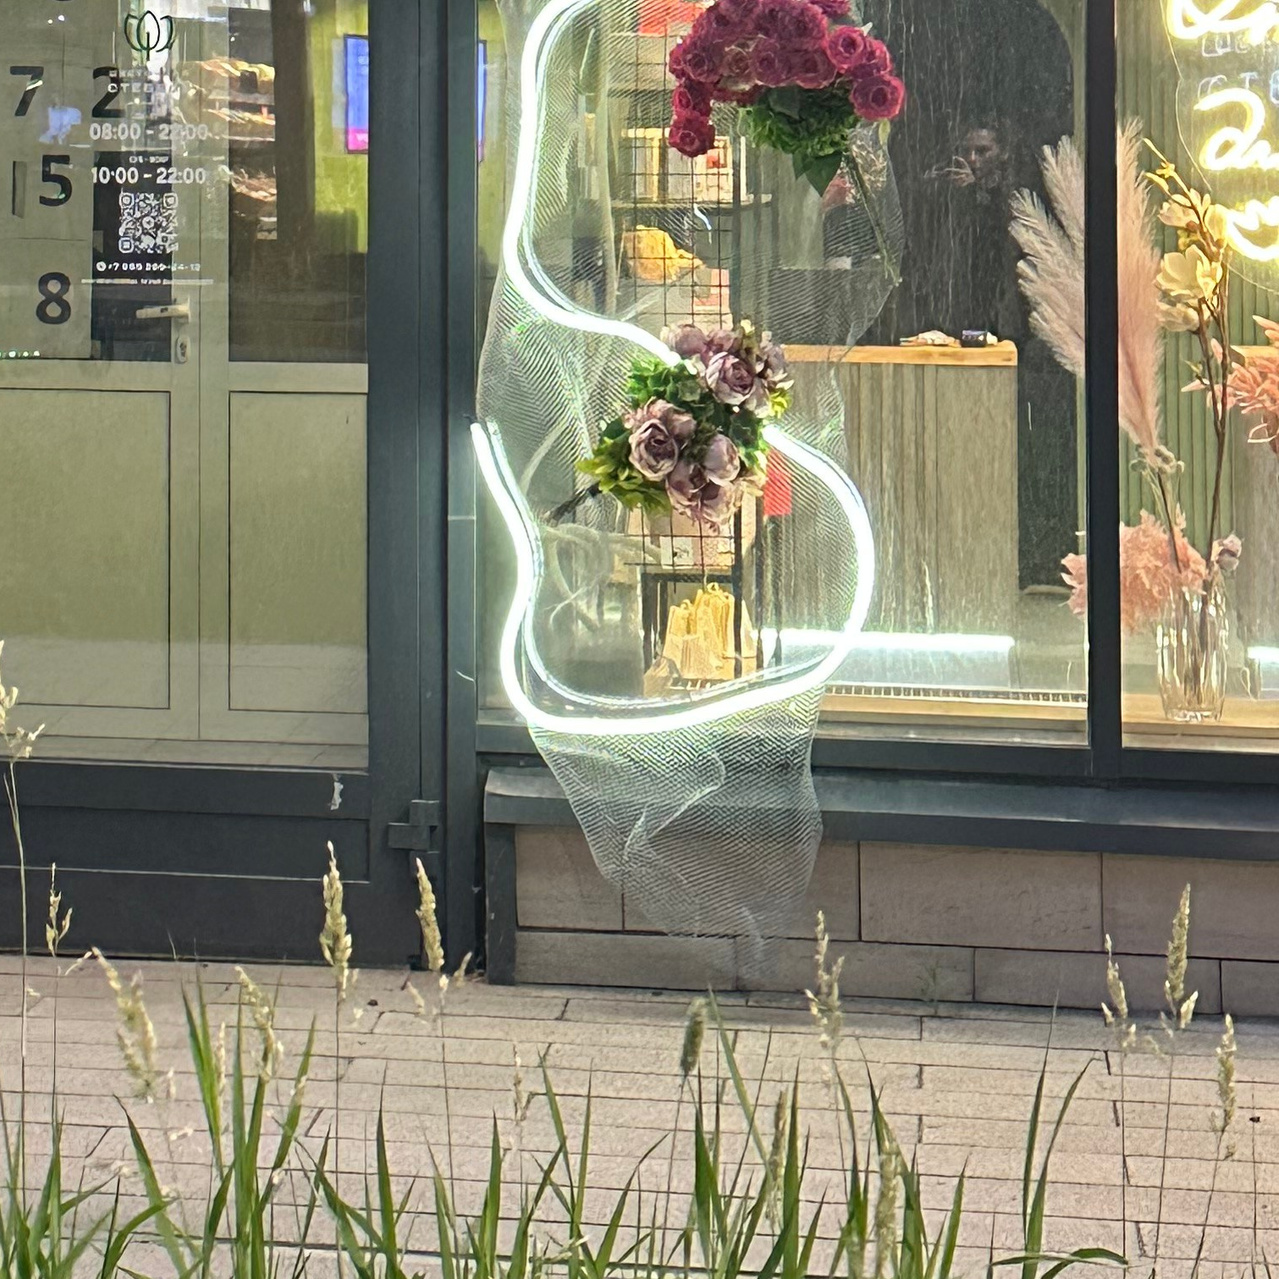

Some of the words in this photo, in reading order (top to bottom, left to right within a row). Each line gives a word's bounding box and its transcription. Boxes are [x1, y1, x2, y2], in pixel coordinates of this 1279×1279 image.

[90, 123, 141, 140] 08:00
[91, 167, 139, 184] 10:00
[156, 167, 206, 184] 22:00
